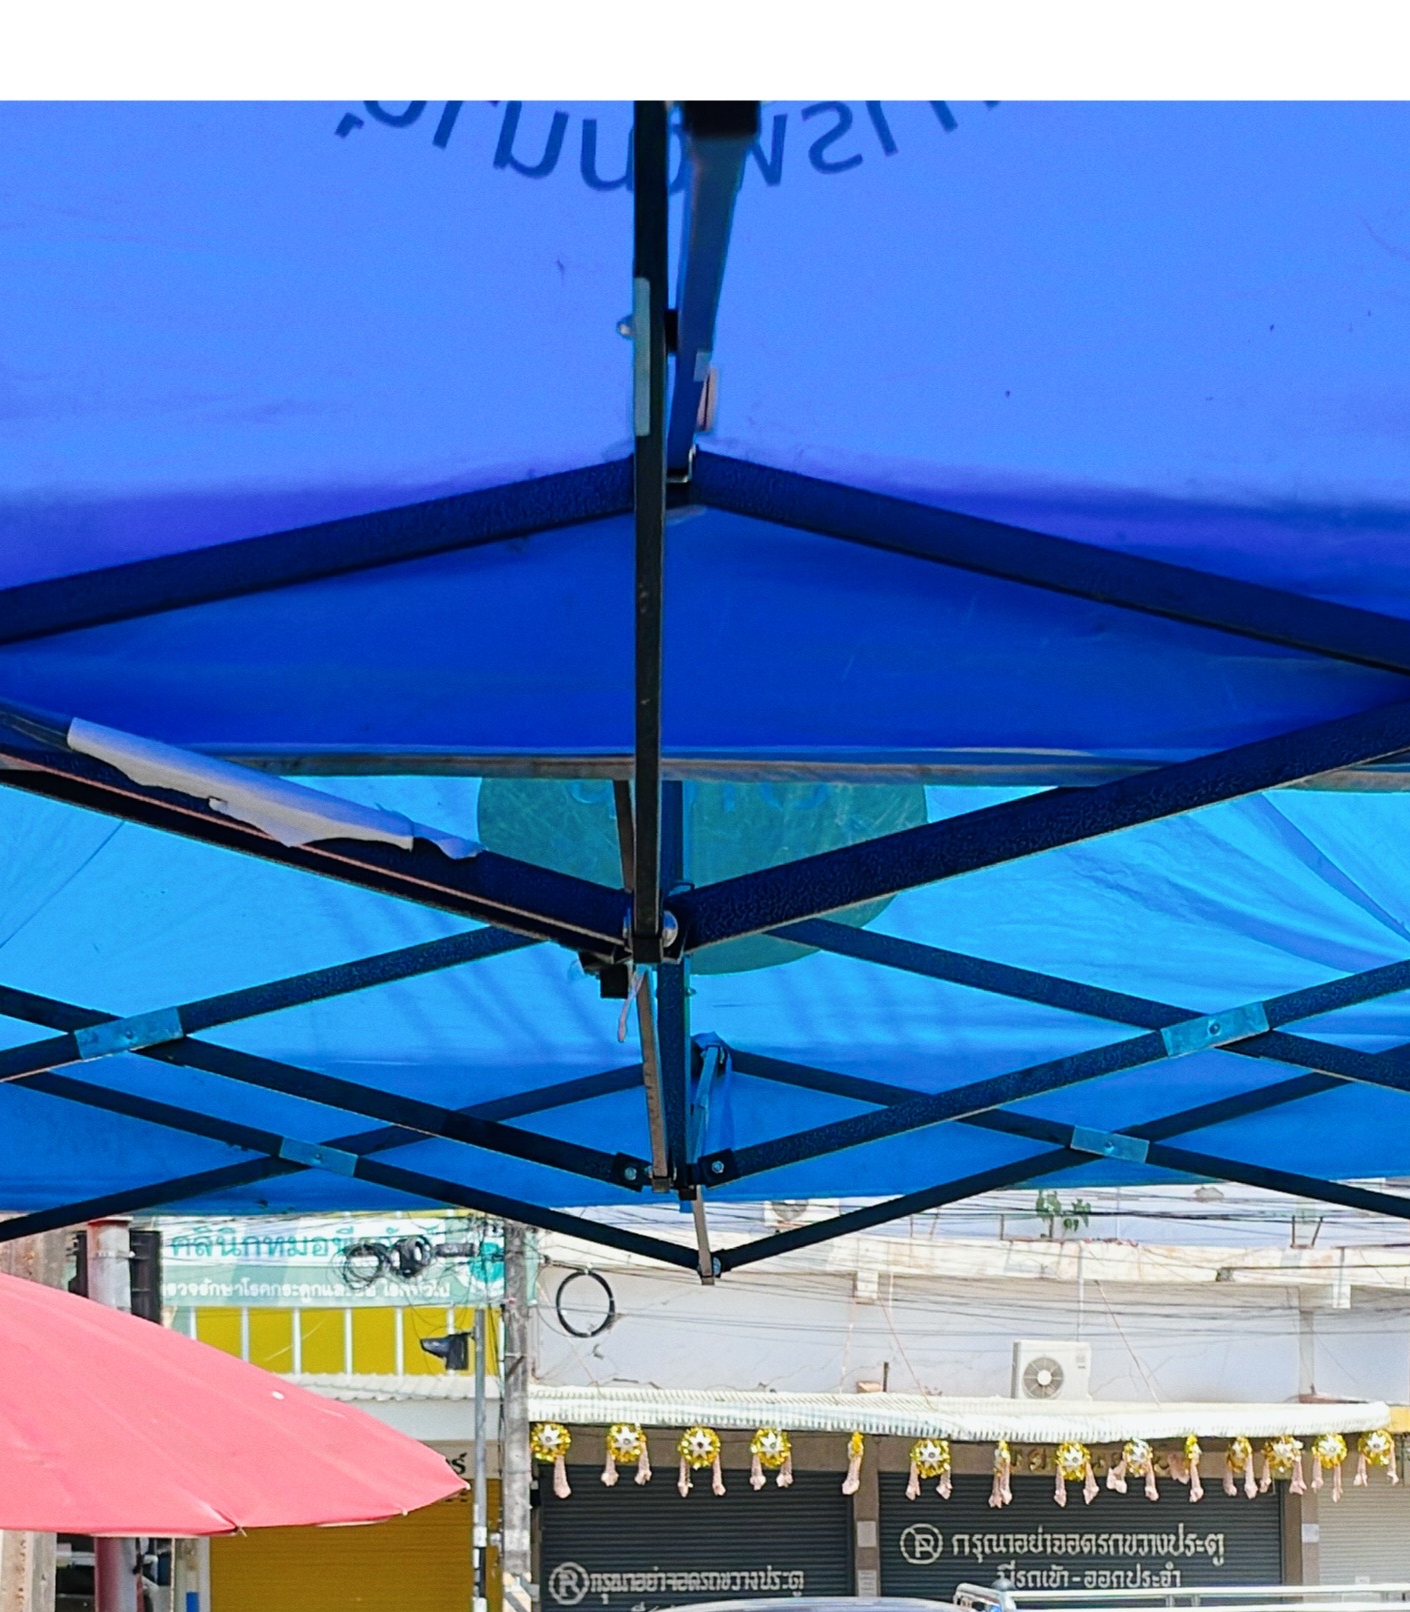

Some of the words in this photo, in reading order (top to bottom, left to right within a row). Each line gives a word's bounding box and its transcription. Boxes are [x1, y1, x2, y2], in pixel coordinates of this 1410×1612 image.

[951, 1522, 1225, 1567] กรุณาอย่าจอดรถขวางประตู
